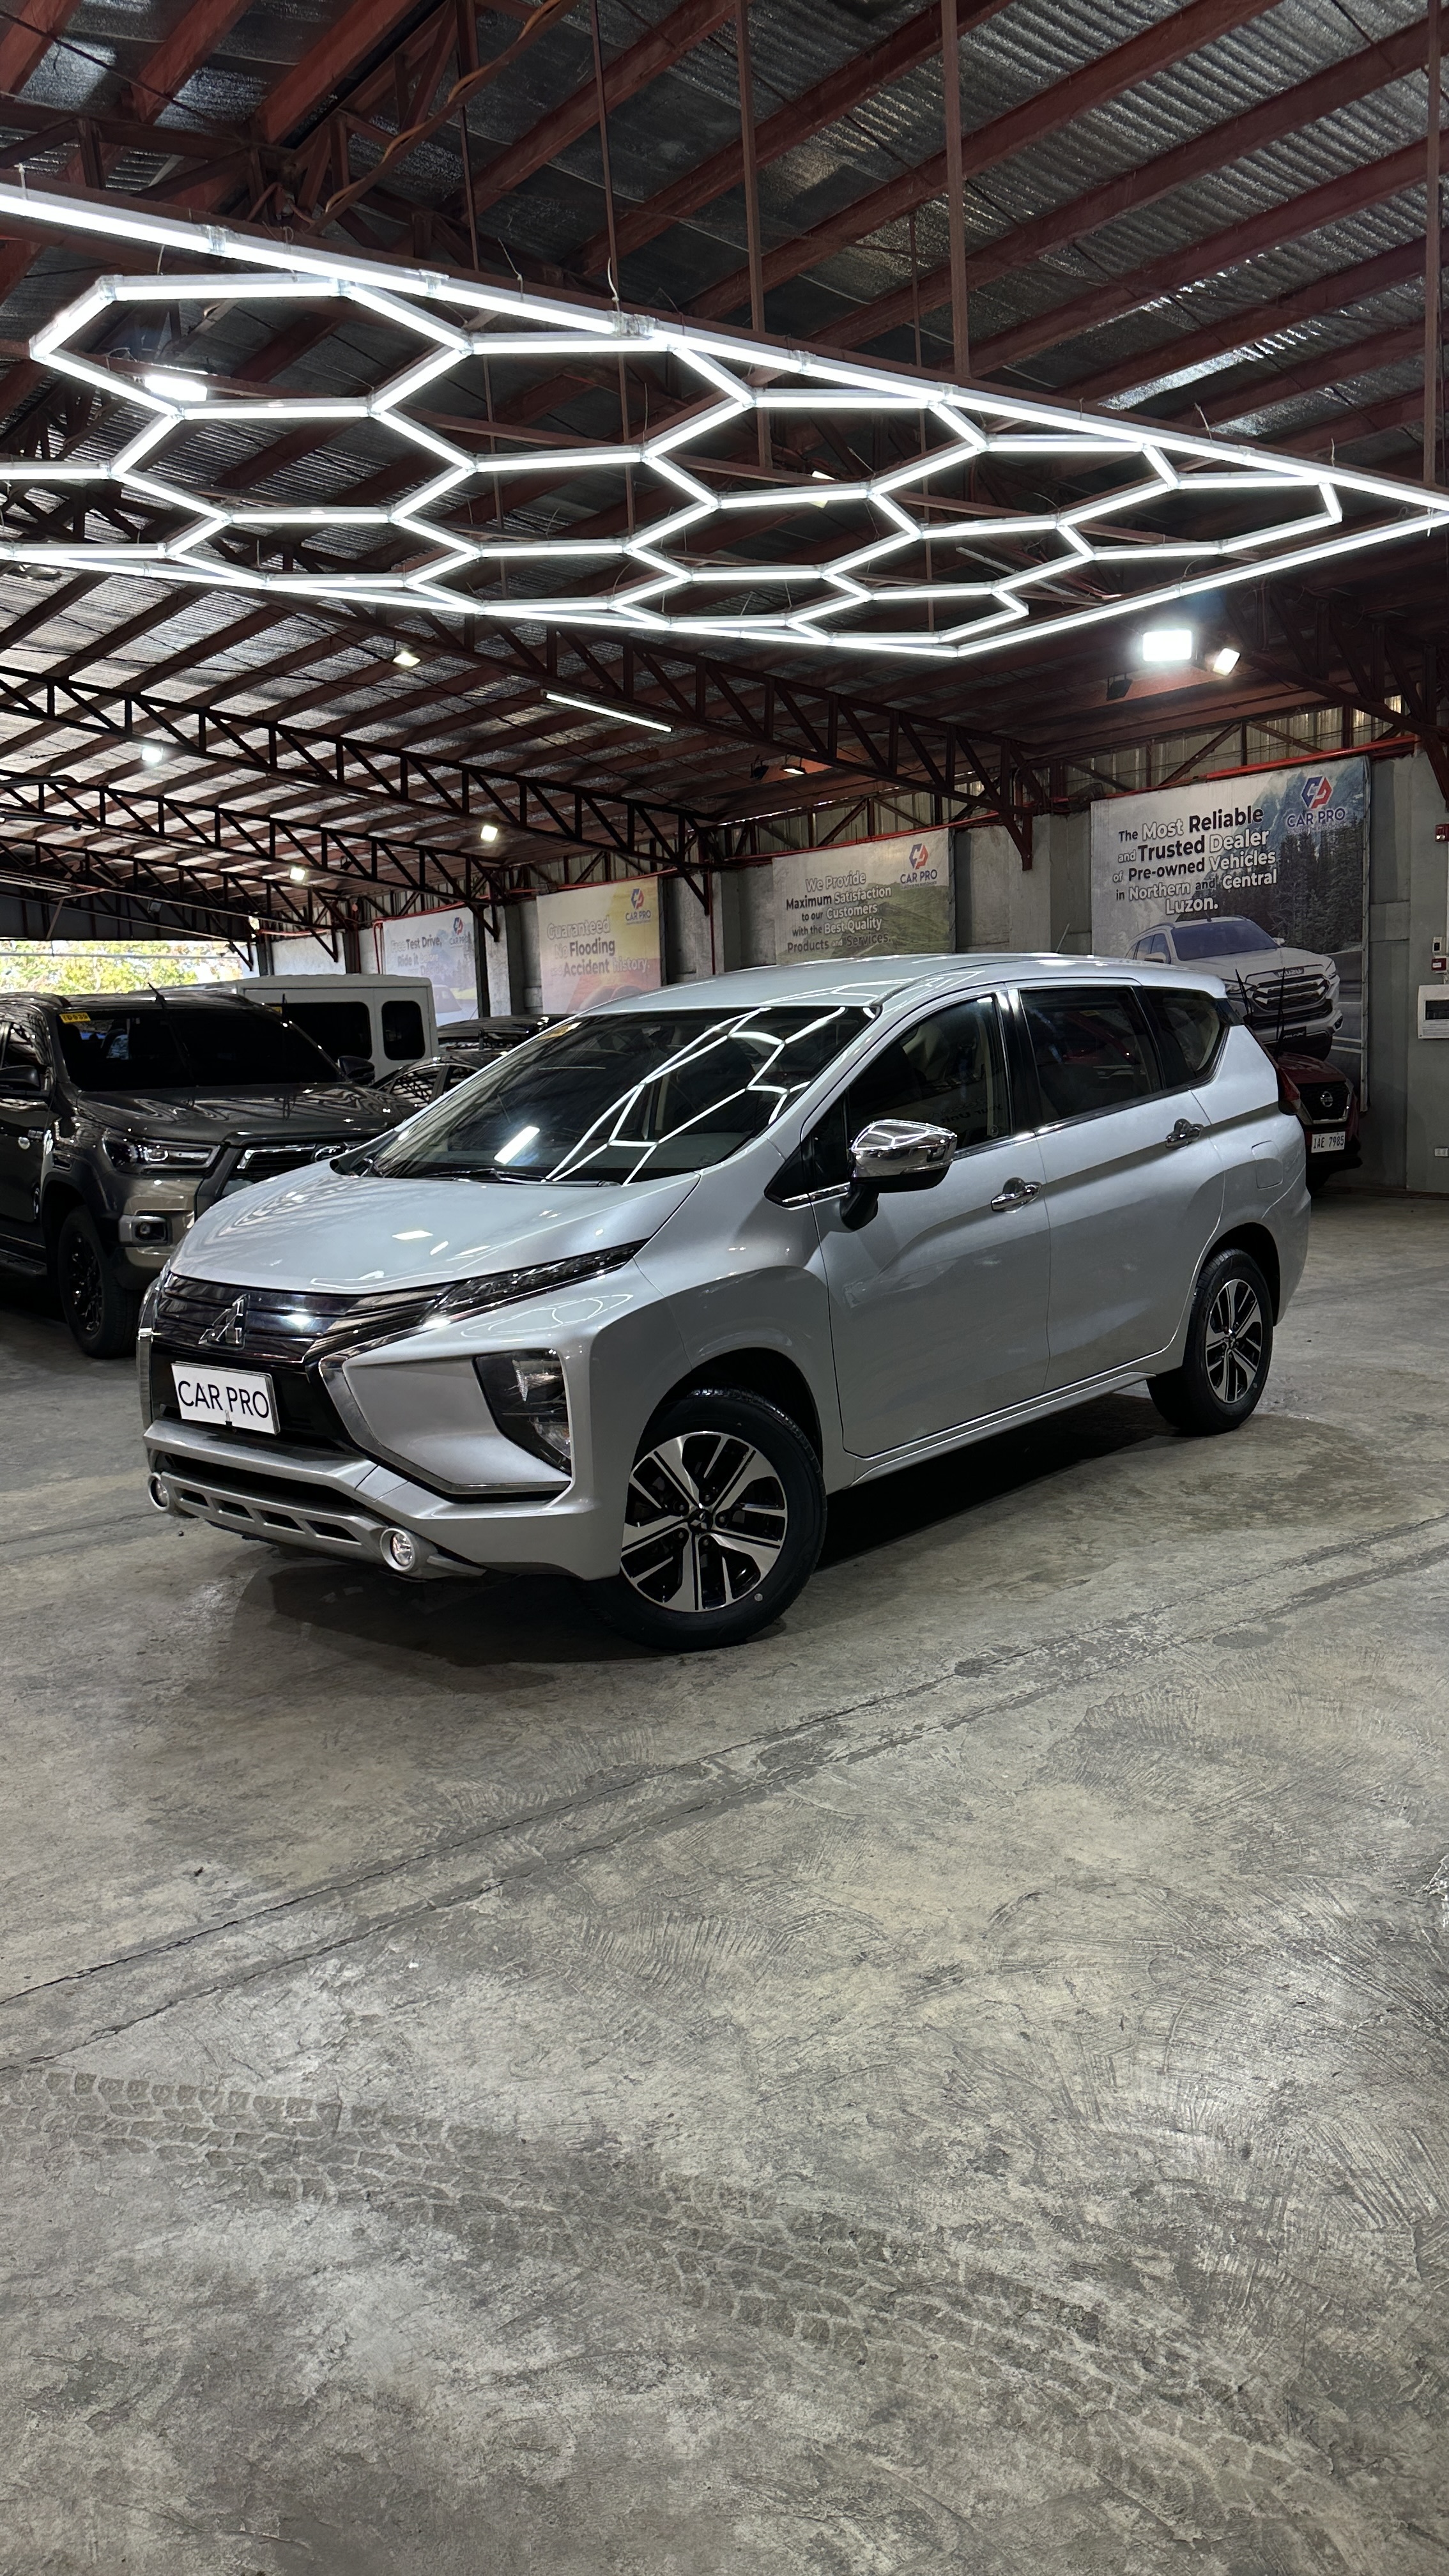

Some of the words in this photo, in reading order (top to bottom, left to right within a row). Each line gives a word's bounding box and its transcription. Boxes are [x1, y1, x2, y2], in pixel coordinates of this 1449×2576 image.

[1119, 830, 1138, 843] The
[1142, 818, 1184, 841] Most
[1189, 806, 1264, 833] Reliable
[1287, 812, 1314, 827] CAR
[1318, 808, 1346, 824] PRO
[1118, 850, 1136, 863] and
[1138, 835, 1205, 862] Trusted
[1209, 829, 1269, 853] Dealer
[900, 872, 917, 884] CAR
[920, 869, 938, 881] PRO
[1112, 870, 1124, 883] of
[1128, 857, 1205, 881] Pre-owned
[1209, 850, 1276, 871] Vehicles
[806, 878, 824, 893] We
[825, 870, 866, 889] Provide
[1116, 889, 1125, 900] in
[1129, 882, 1191, 901] Northern
[1195, 878, 1216, 891] and
[1222, 868, 1277, 890] Central
[786, 895, 832, 910] Maximum
[834, 885, 891, 904] Satisfaction
[1165, 896, 1218, 915] Luzon.
[625, 912, 638, 921] CAR
[639, 910, 651, 919] PRO
[802, 913, 809, 921] to
[811, 912, 824, 921] our
[827, 903, 878, 919] Customers
[547, 915, 611, 940] Guaranteed
[792, 926, 808, 937] with
[810, 925, 822, 935] the
[824, 923, 845, 935] Best
[847, 916, 882, 933] Quality
[406, 938, 420, 950] Test
[422, 935, 442, 947] Drive,
[569, 937, 615, 956] Flooding
[787, 939, 829, 953] Products
[847, 932, 891, 947] Services.
[563, 959, 610, 977] Accident
[612, 956, 650, 974] history.
[1314, 1137, 1325, 1149] IAE
[1329, 1135, 1344, 1147] 7985
[178, 1381, 224, 1411] CAR
[226, 1386, 269, 1418] PRO
